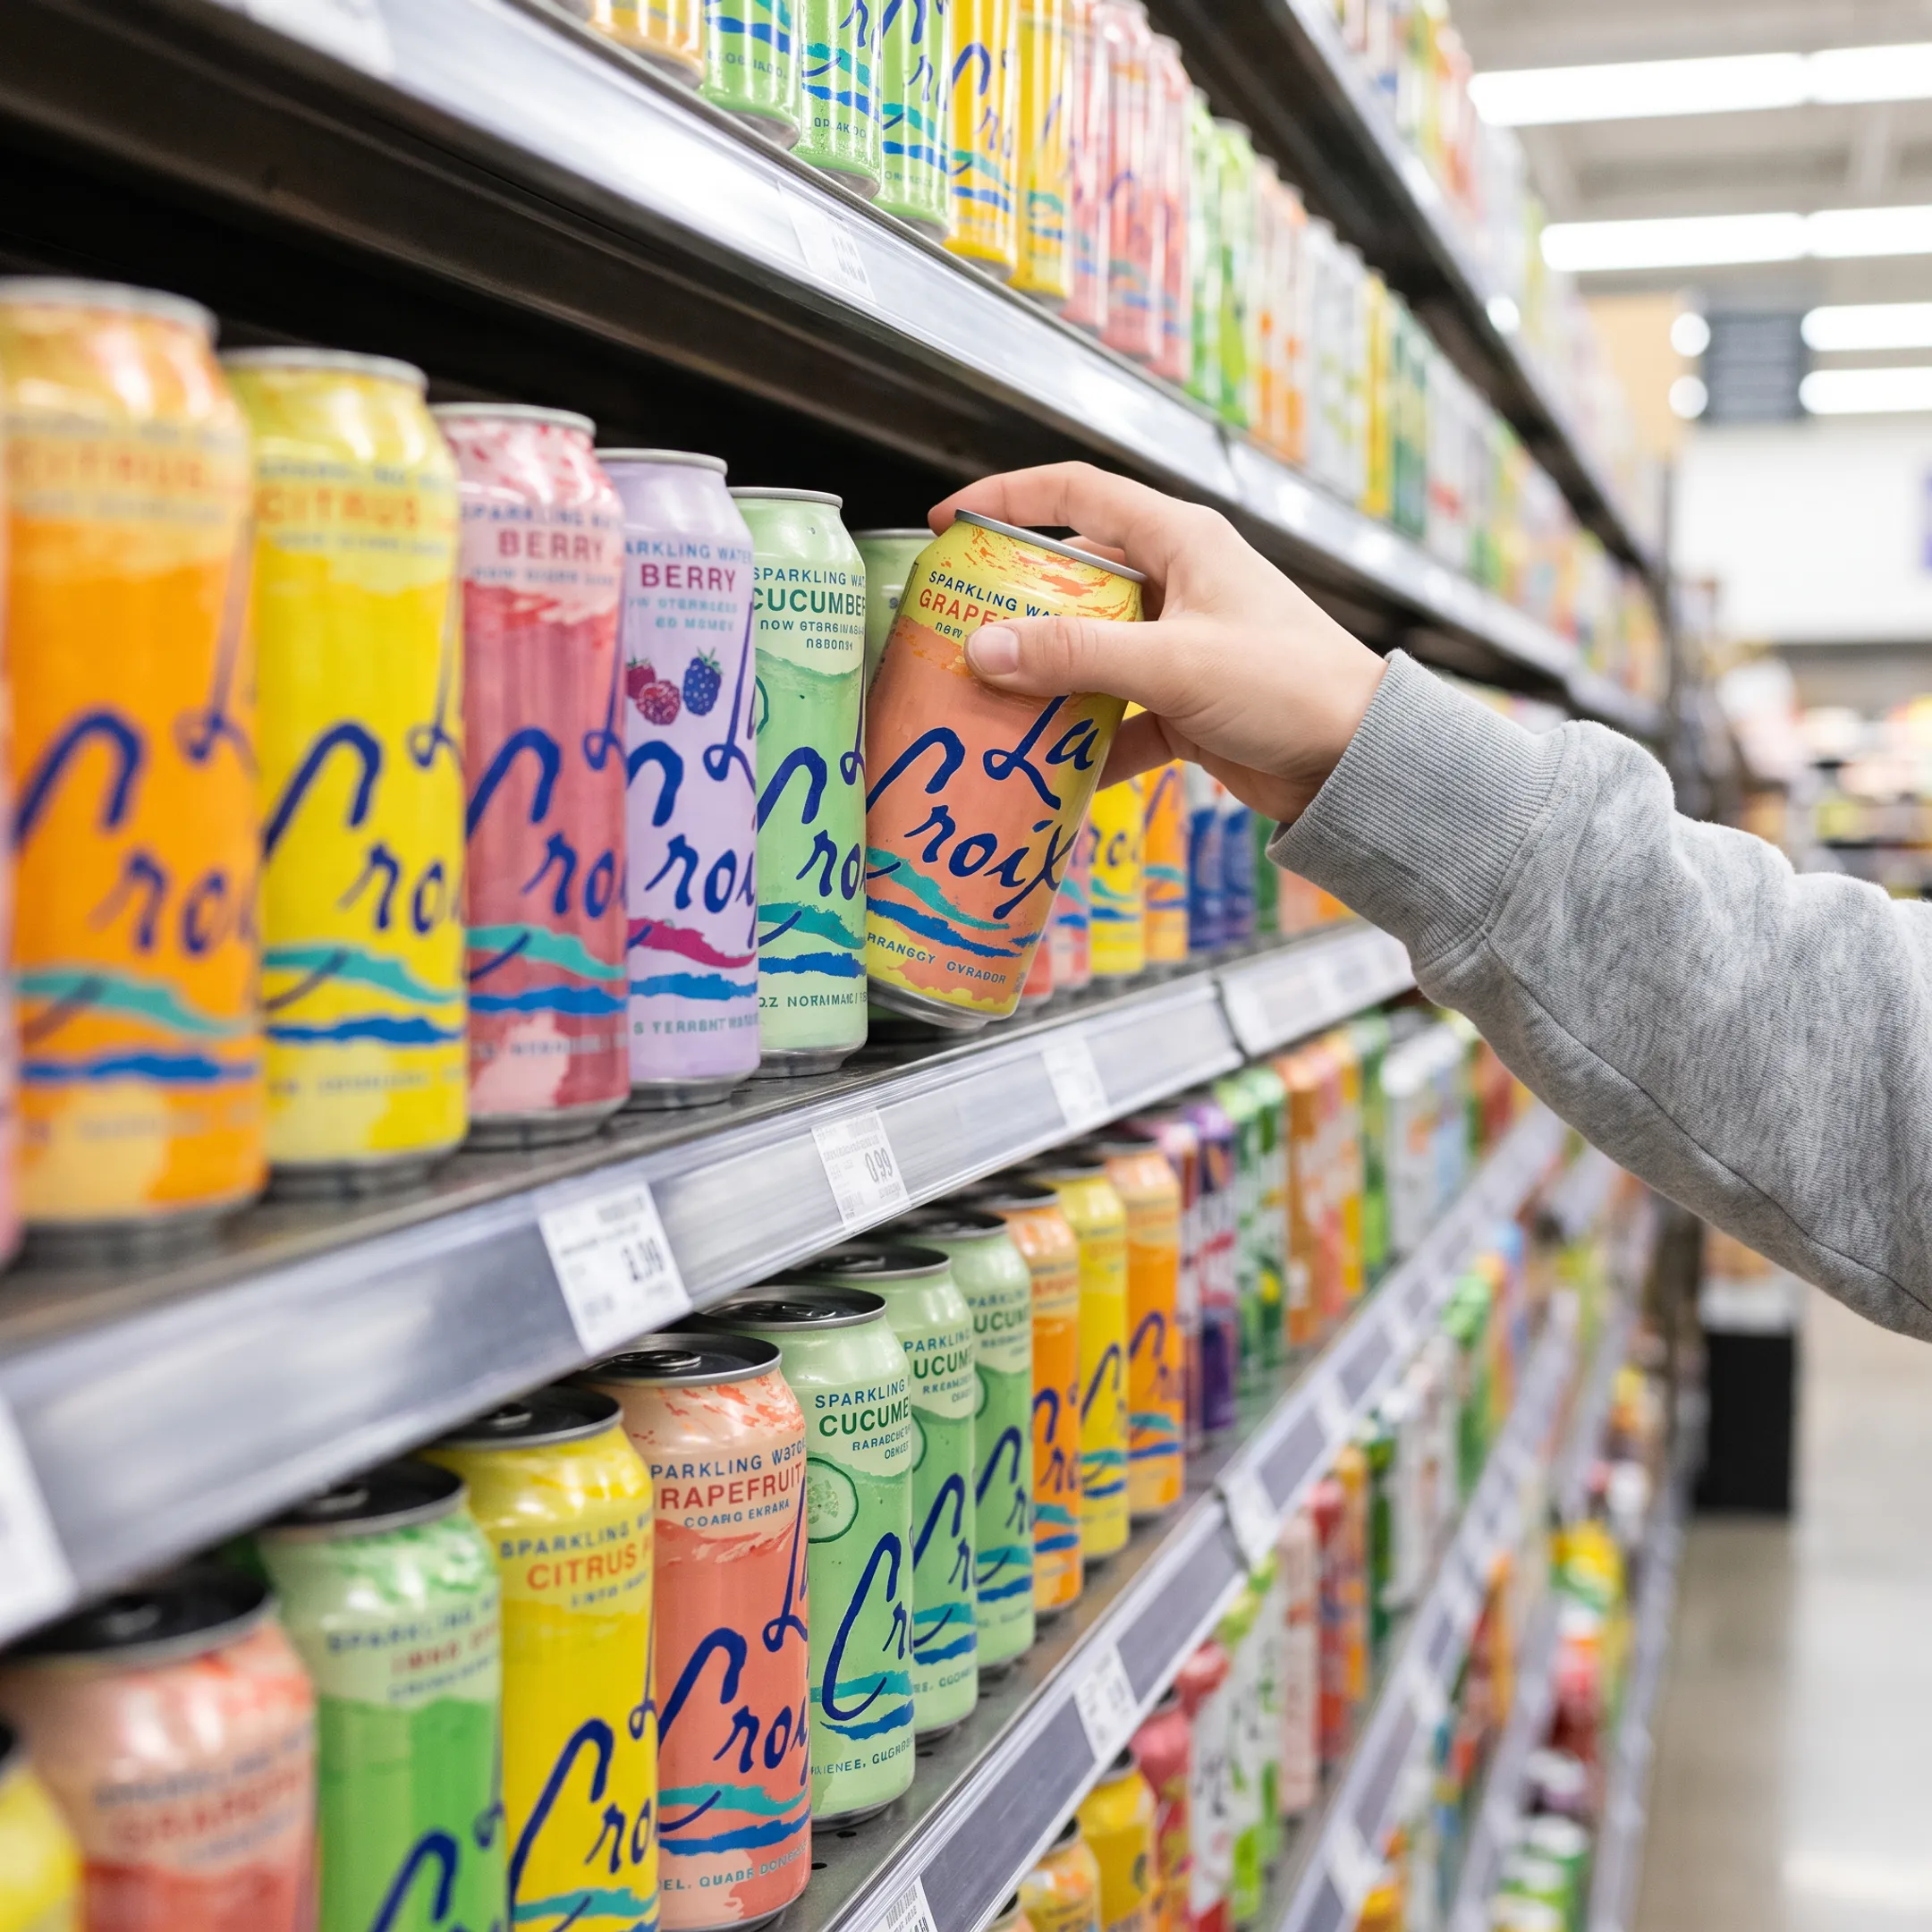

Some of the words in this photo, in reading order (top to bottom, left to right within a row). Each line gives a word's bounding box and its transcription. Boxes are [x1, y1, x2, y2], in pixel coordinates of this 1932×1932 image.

[497, 528, 603, 562] BERRY
[640, 563, 736, 593] BERRY
[928, 571, 1018, 612] SPARKLING
[982, 694, 1100, 811] La
[815, 1378, 905, 1409] SPARKLING
[660, 1461, 802, 1510] RAPEFRUIT
[526, 1541, 637, 1591] CITRUS
[822, 1531, 913, 1722] Cr
